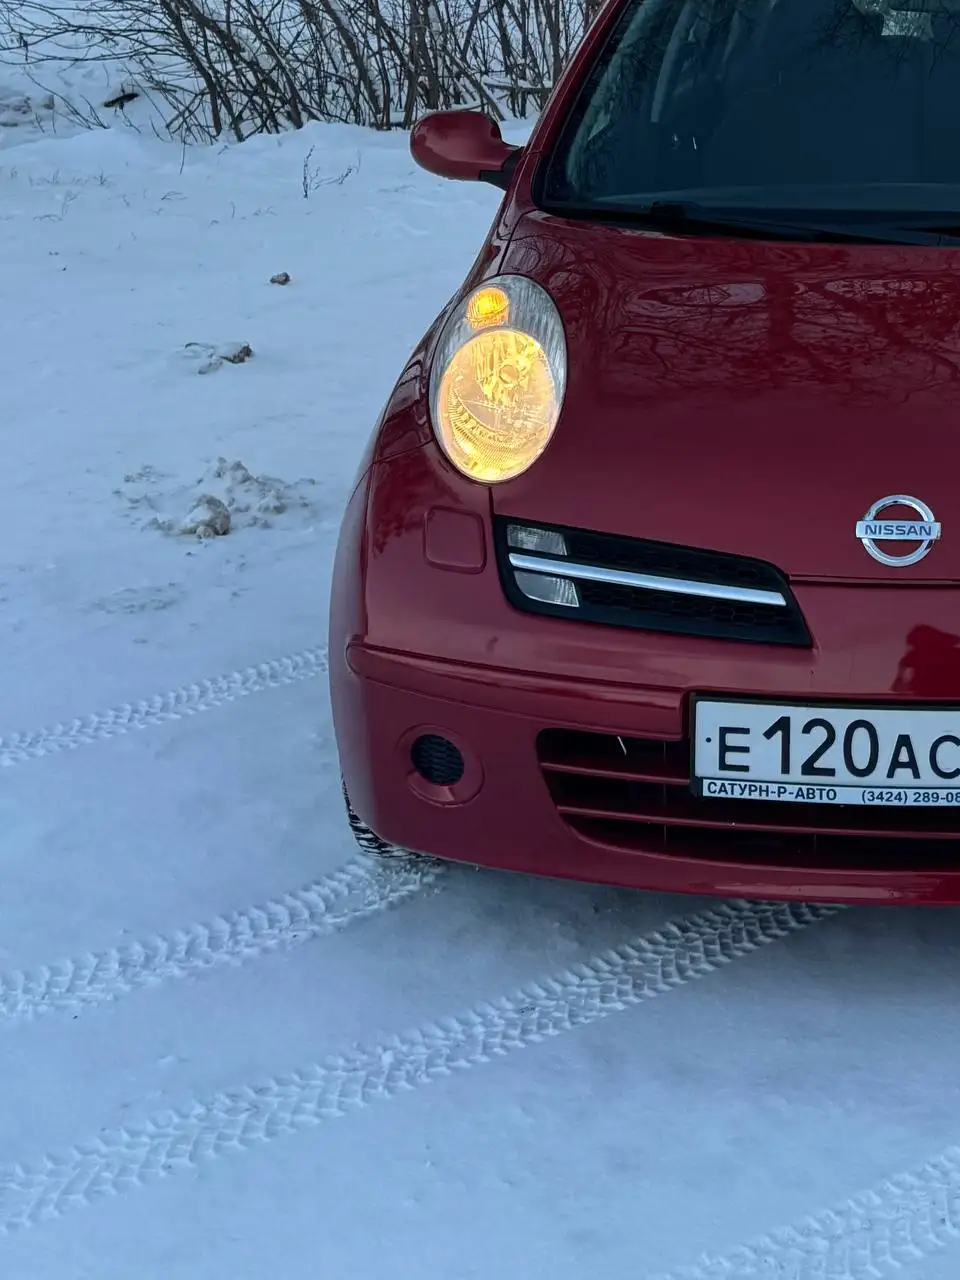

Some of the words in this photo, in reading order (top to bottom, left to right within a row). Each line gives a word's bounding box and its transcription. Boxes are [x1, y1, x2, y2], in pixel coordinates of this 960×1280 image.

[864, 524, 932, 536] NISSAN
[706, 780, 838, 801] САТУРН-Р-АВТО
[861, 789, 908, 804] (3424)
